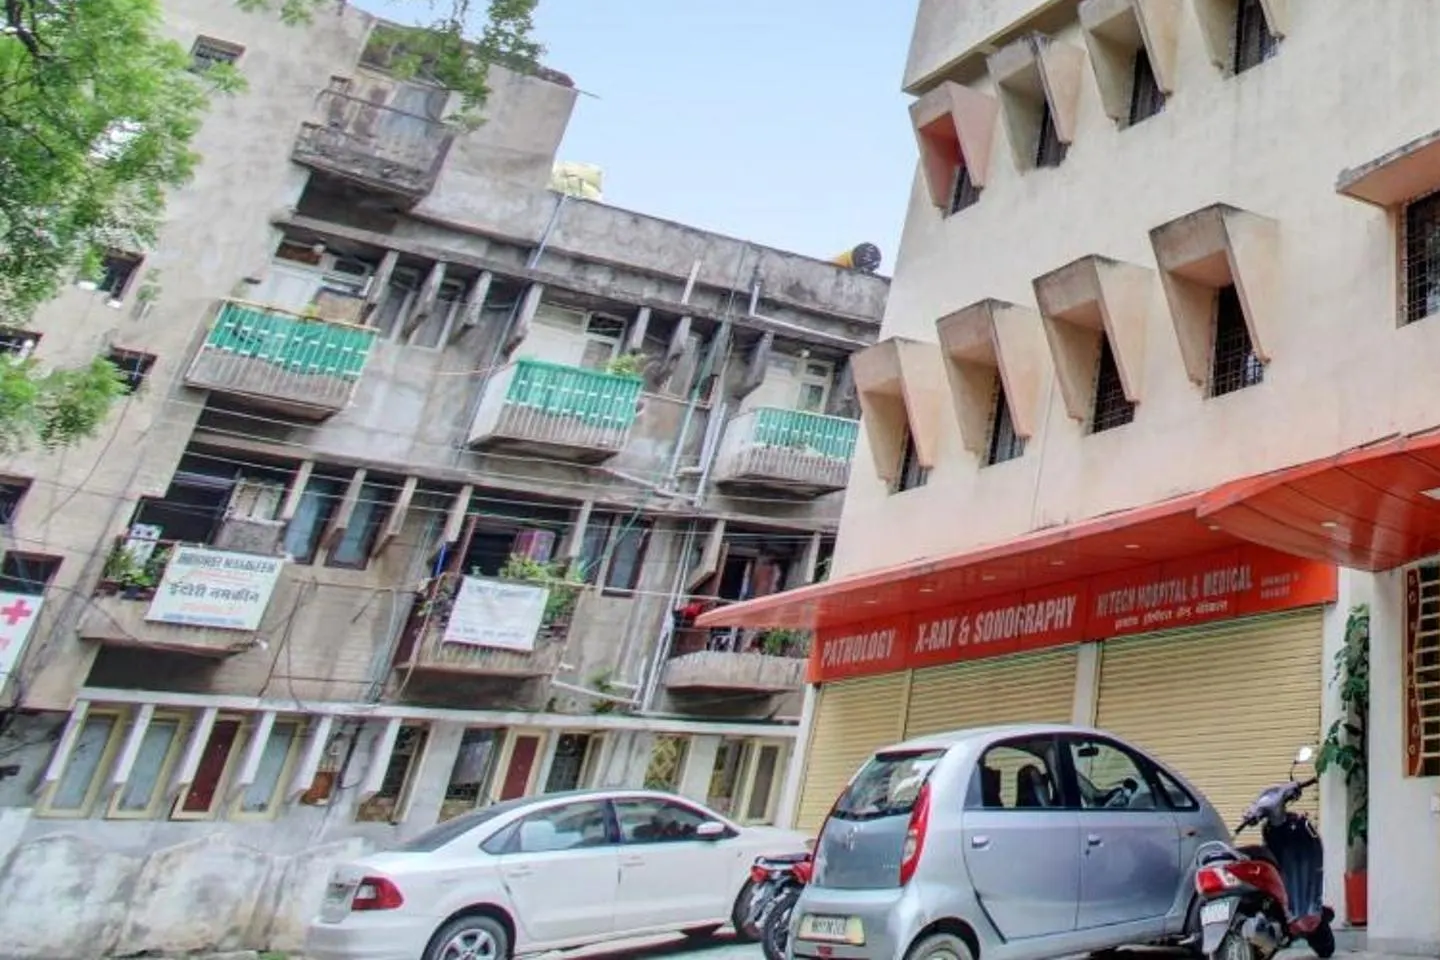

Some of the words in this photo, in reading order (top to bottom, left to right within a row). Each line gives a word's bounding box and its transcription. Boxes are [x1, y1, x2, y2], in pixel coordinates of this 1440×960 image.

[1138, 577, 1187, 609] HOSPITAL
[1203, 566, 1253, 596] MEDICAL
[915, 617, 957, 653] X-RAY
[959, 615, 971, 645] &
[974, 595, 1077, 644] SONOGRAPHY
[821, 628, 896, 668] PATHOLOGY
